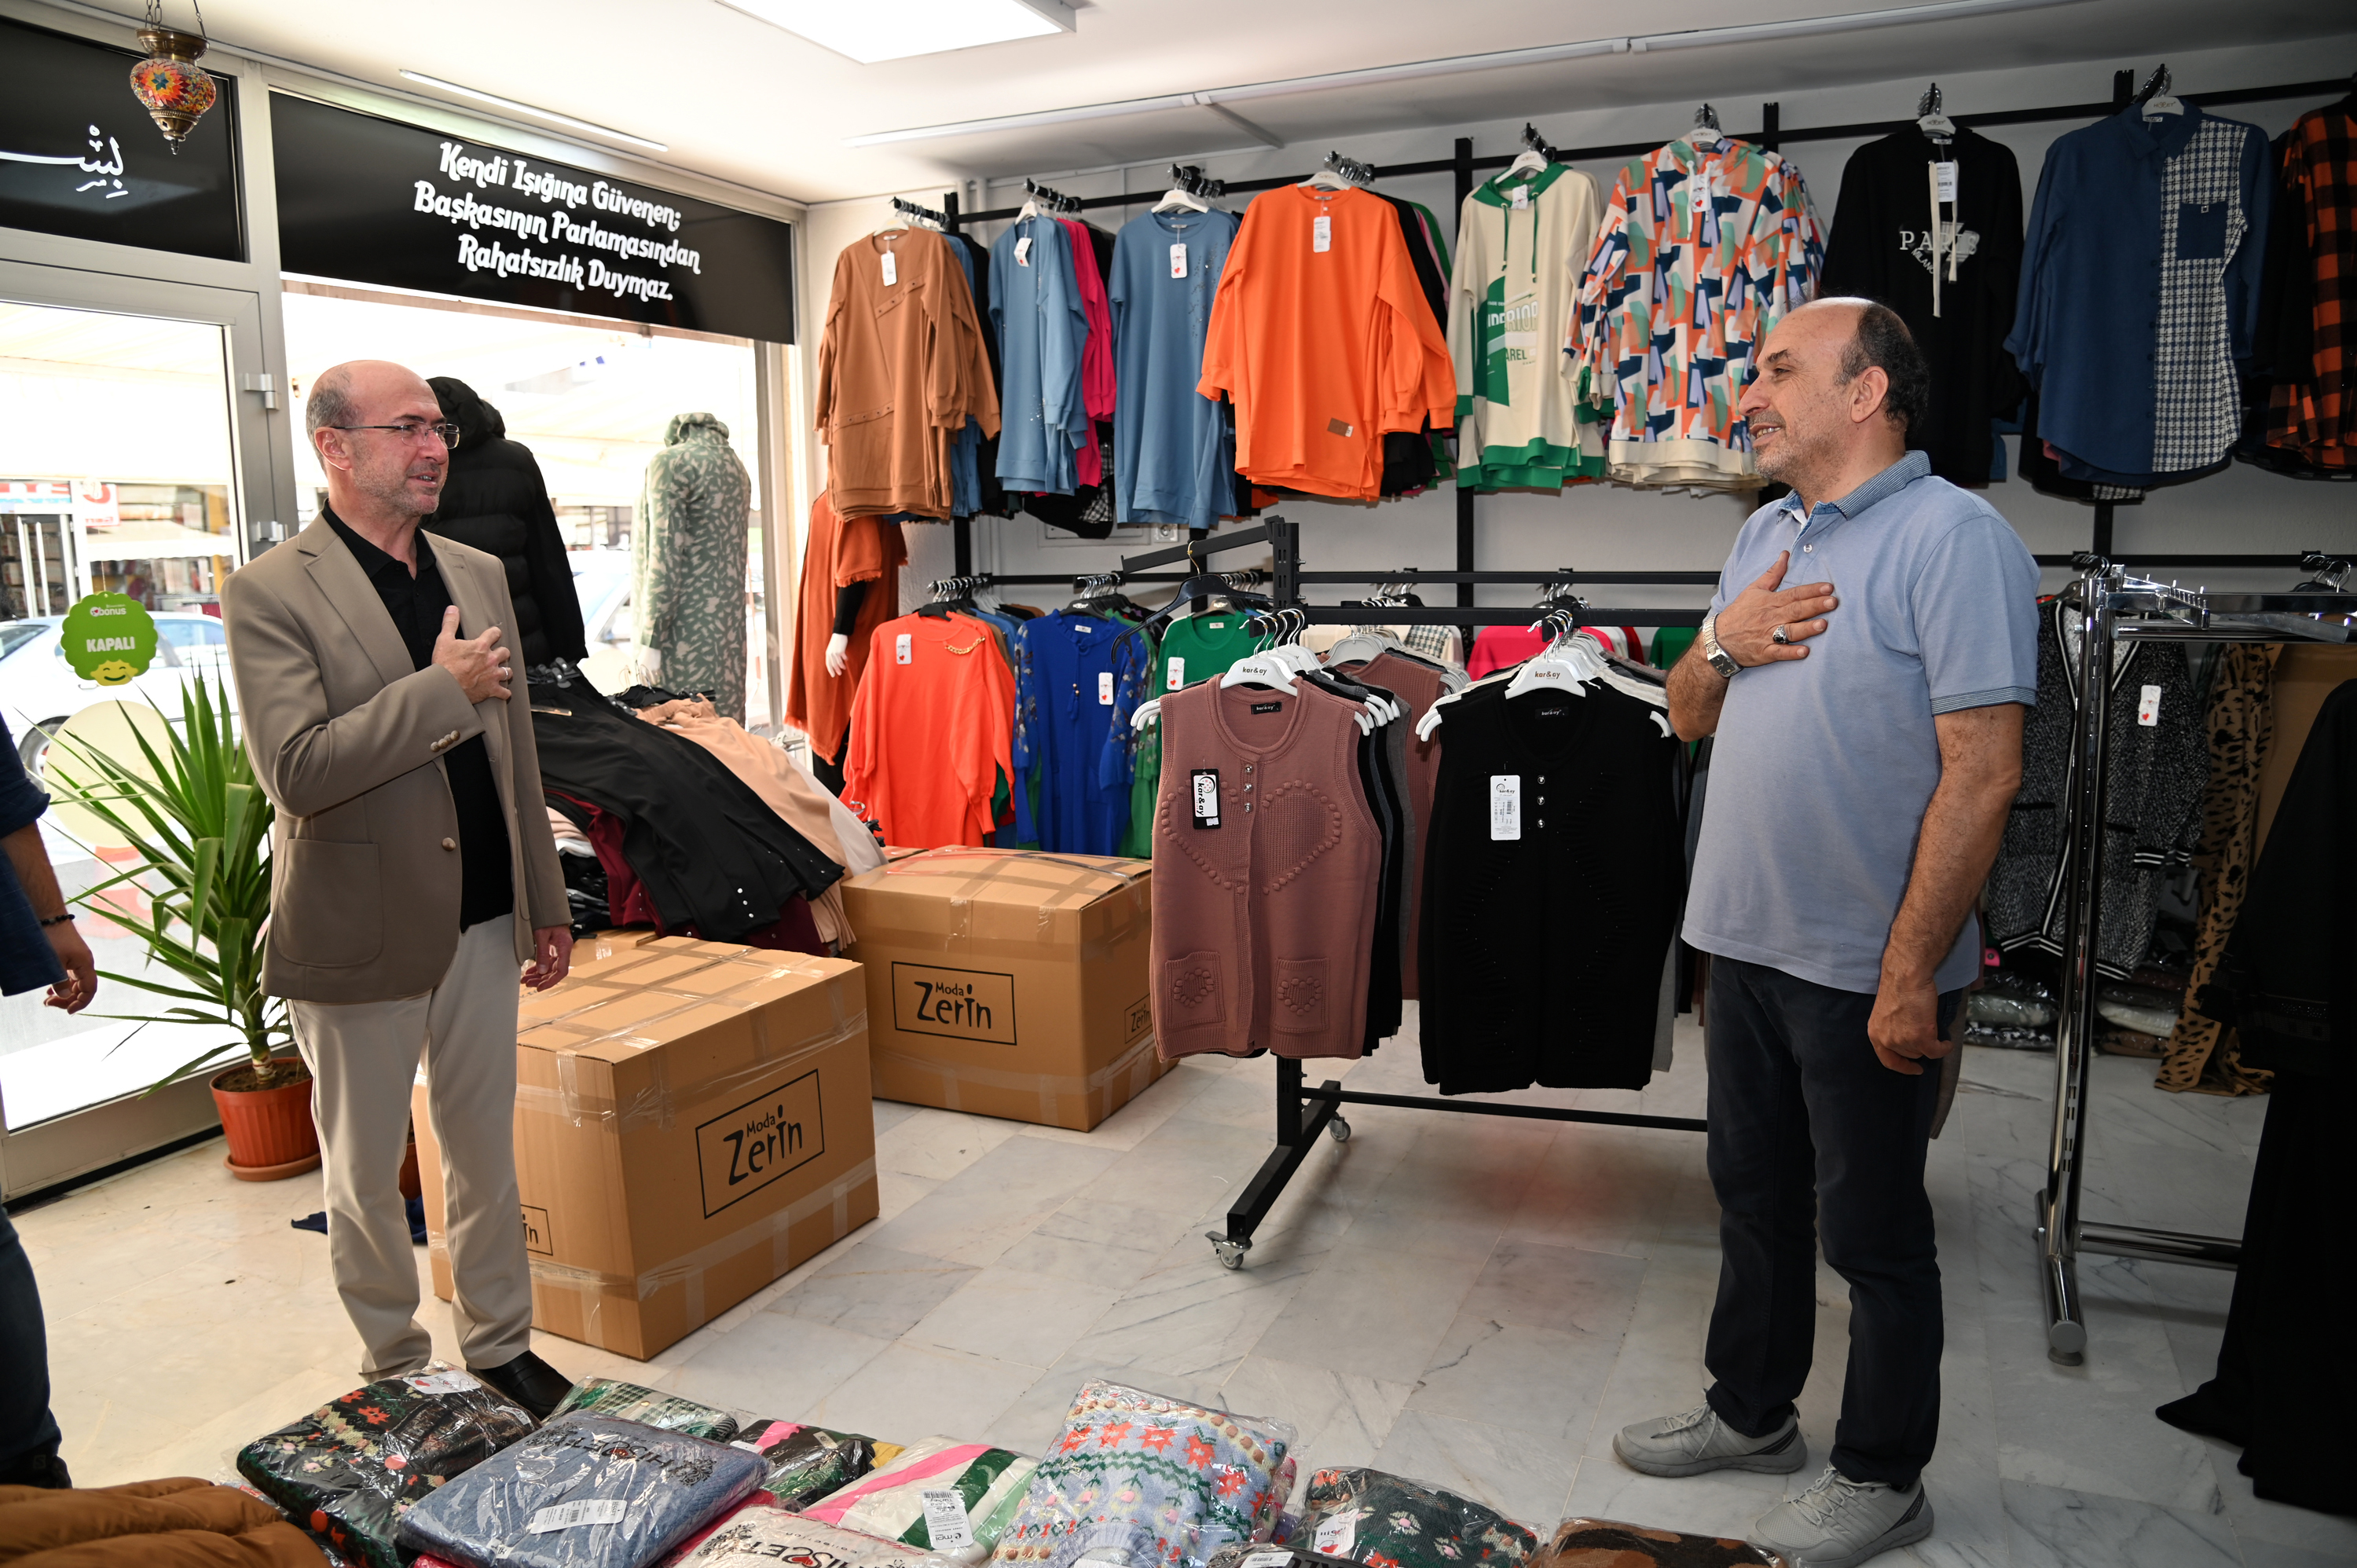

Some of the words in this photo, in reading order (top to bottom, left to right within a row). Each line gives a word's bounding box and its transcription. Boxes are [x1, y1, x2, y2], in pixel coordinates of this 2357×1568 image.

[439, 141, 508, 188] Kendi
[512, 160, 588, 209] Işığına
[592, 181, 682, 232] Güvenen;
[414, 181, 548, 244] Başkasının
[552, 211, 702, 274] Parlamasından
[458, 233, 585, 291] Rahatsızlık
[588, 258, 674, 302] Duymaz.
[99, 607, 127, 616] bonus
[86, 636, 135, 653] KAPALI
[1242, 666, 1267, 676] kar&ay
[1534, 671, 1560, 680] kar&ay
[935, 981, 964, 996] Moda
[914, 981, 992, 1029] Zerin
[747, 1112, 775, 1138] Moda
[723, 1104, 802, 1185] Zerin
